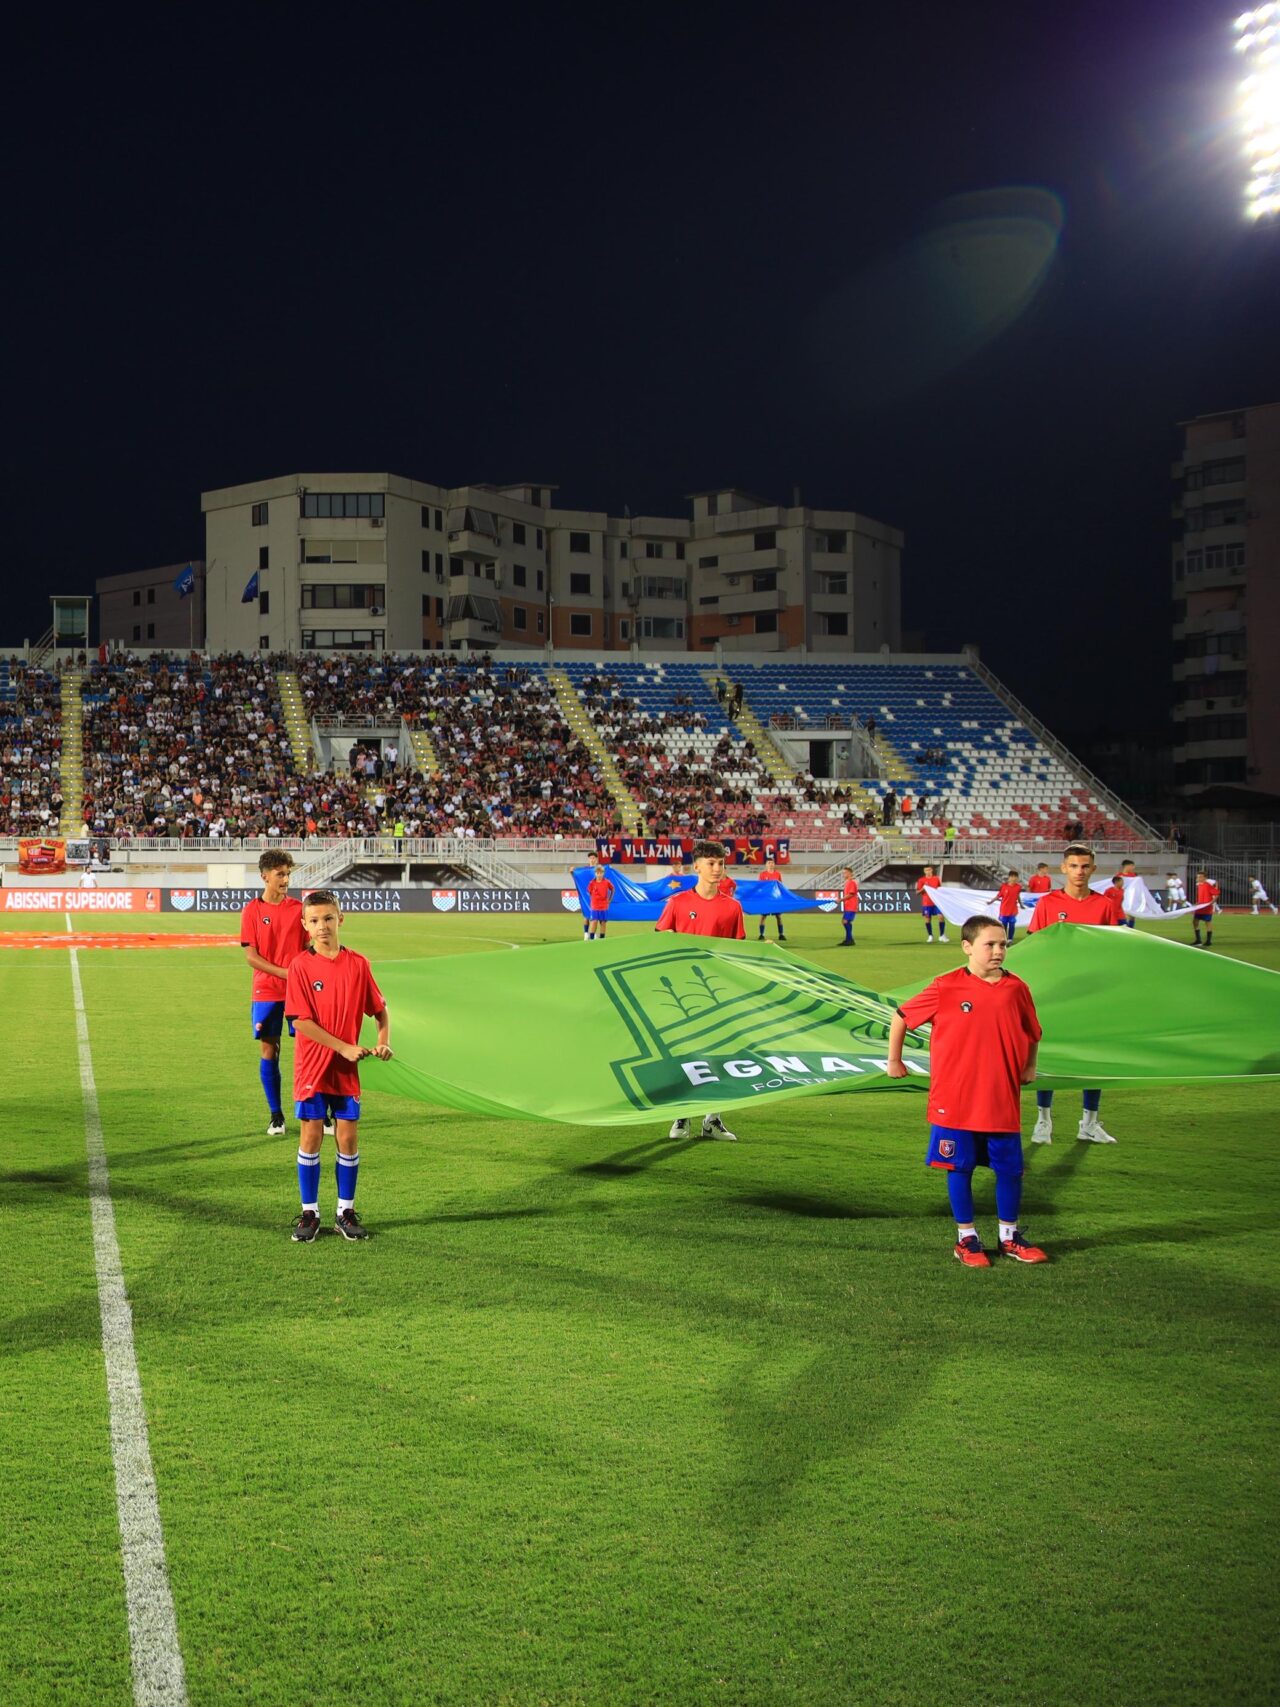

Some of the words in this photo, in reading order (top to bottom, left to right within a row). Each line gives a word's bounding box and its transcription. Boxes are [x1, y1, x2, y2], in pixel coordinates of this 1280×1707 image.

[601, 844, 617, 858] KF
[625, 844, 683, 858] VLLAZNIA
[780, 843, 788, 859] 5
[5, 892, 63, 909] ABISSNET
[65, 892, 132, 909] SUPERIORE
[202, 890, 259, 900] BASHKI
[463, 891, 530, 901] BASHKIA
[857, 891, 911, 901] ASHKIA
[340, 900, 401, 911] HKODËR
[681, 1056, 929, 1086] EGNATI
